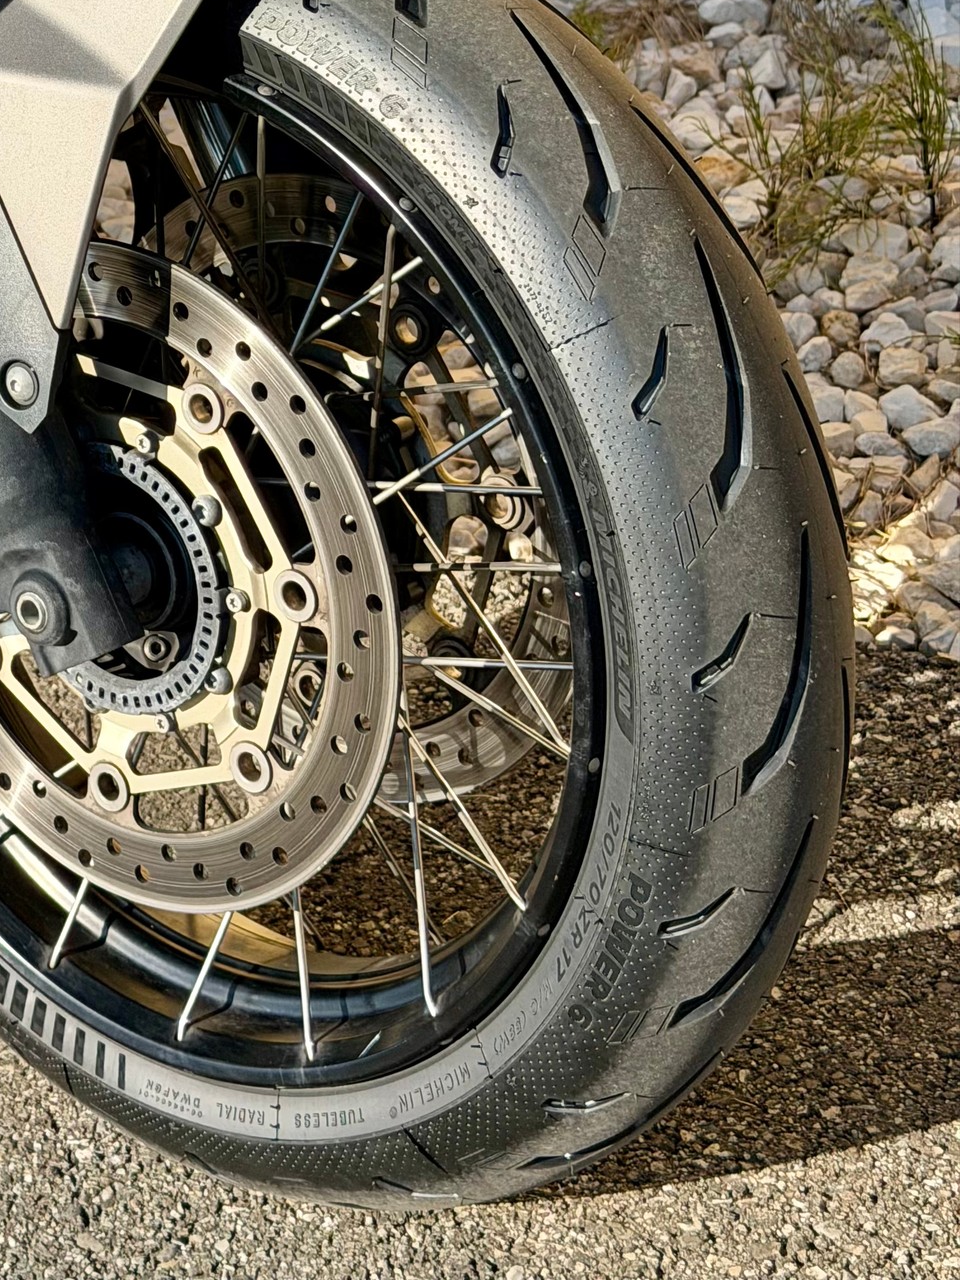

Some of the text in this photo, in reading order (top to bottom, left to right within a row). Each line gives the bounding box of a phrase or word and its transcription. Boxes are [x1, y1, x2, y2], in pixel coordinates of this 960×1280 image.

[253, 7, 409, 120] POWER 6
[418, 183, 478, 250] FRONT
[591, 507, 632, 720] MICHELIN
[590, 801, 622, 906] 120/70
[566, 871, 654, 1032] POWER 6
[216, 1102, 266, 1126] RADIAL
[294, 1107, 366, 1129] TUBELESS
